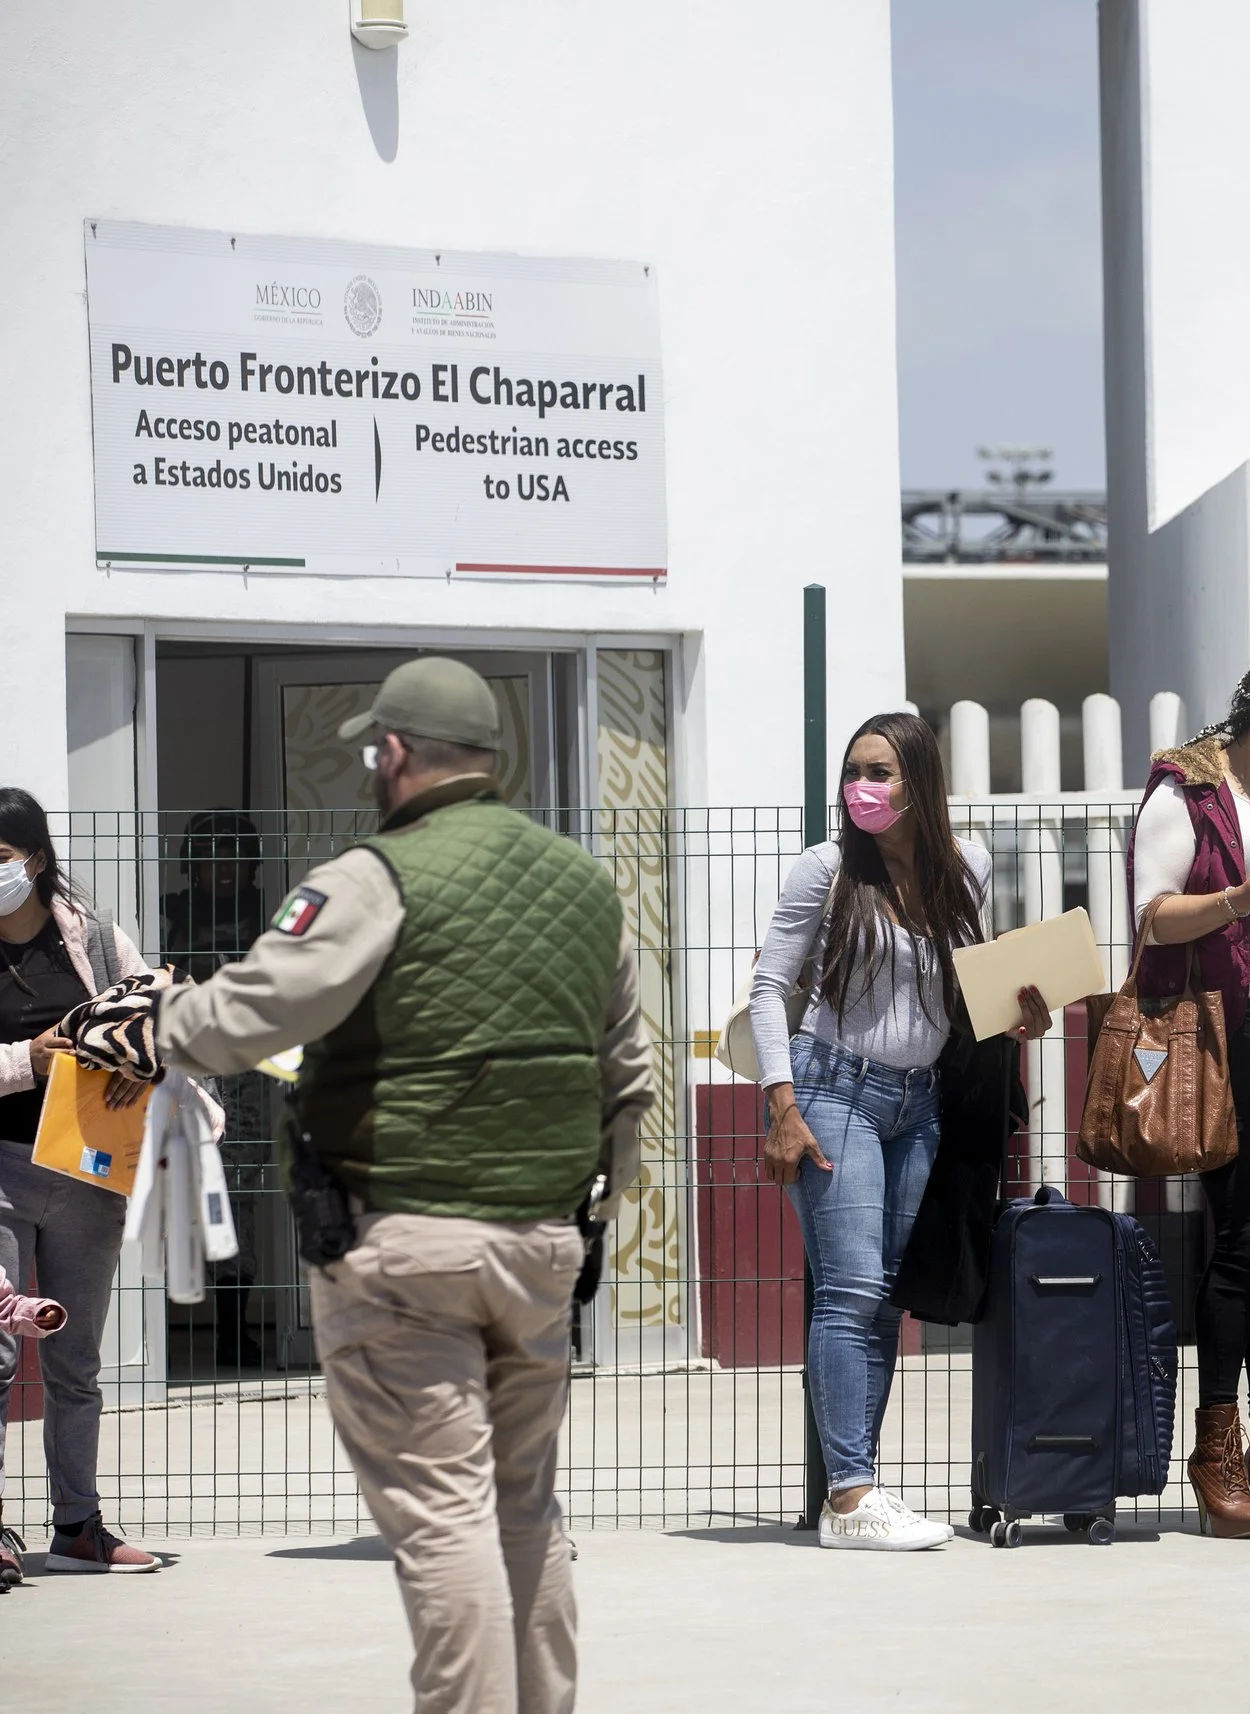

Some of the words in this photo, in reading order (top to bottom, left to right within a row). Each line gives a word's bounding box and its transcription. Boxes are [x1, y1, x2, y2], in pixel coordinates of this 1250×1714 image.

[256, 281, 321, 309] MÉXICO
[412, 288, 493, 312] INDAABIN
[111, 343, 230, 391] Puerto
[240, 352, 421, 401] Fronterizo
[431, 363, 459, 403] El
[469, 366, 646, 419] Chaparral
[134, 409, 221, 442] Acceso
[228, 419, 338, 451] peatonal
[415, 424, 549, 457] Pedestrian
[556, 437, 638, 460] access
[132, 465, 148, 485] a
[154, 457, 251, 490] Estados
[257, 460, 342, 494] Unidos
[483, 475, 511, 501] to
[517, 473, 570, 502] USA
[830, 1519, 890, 1538] GUESS
